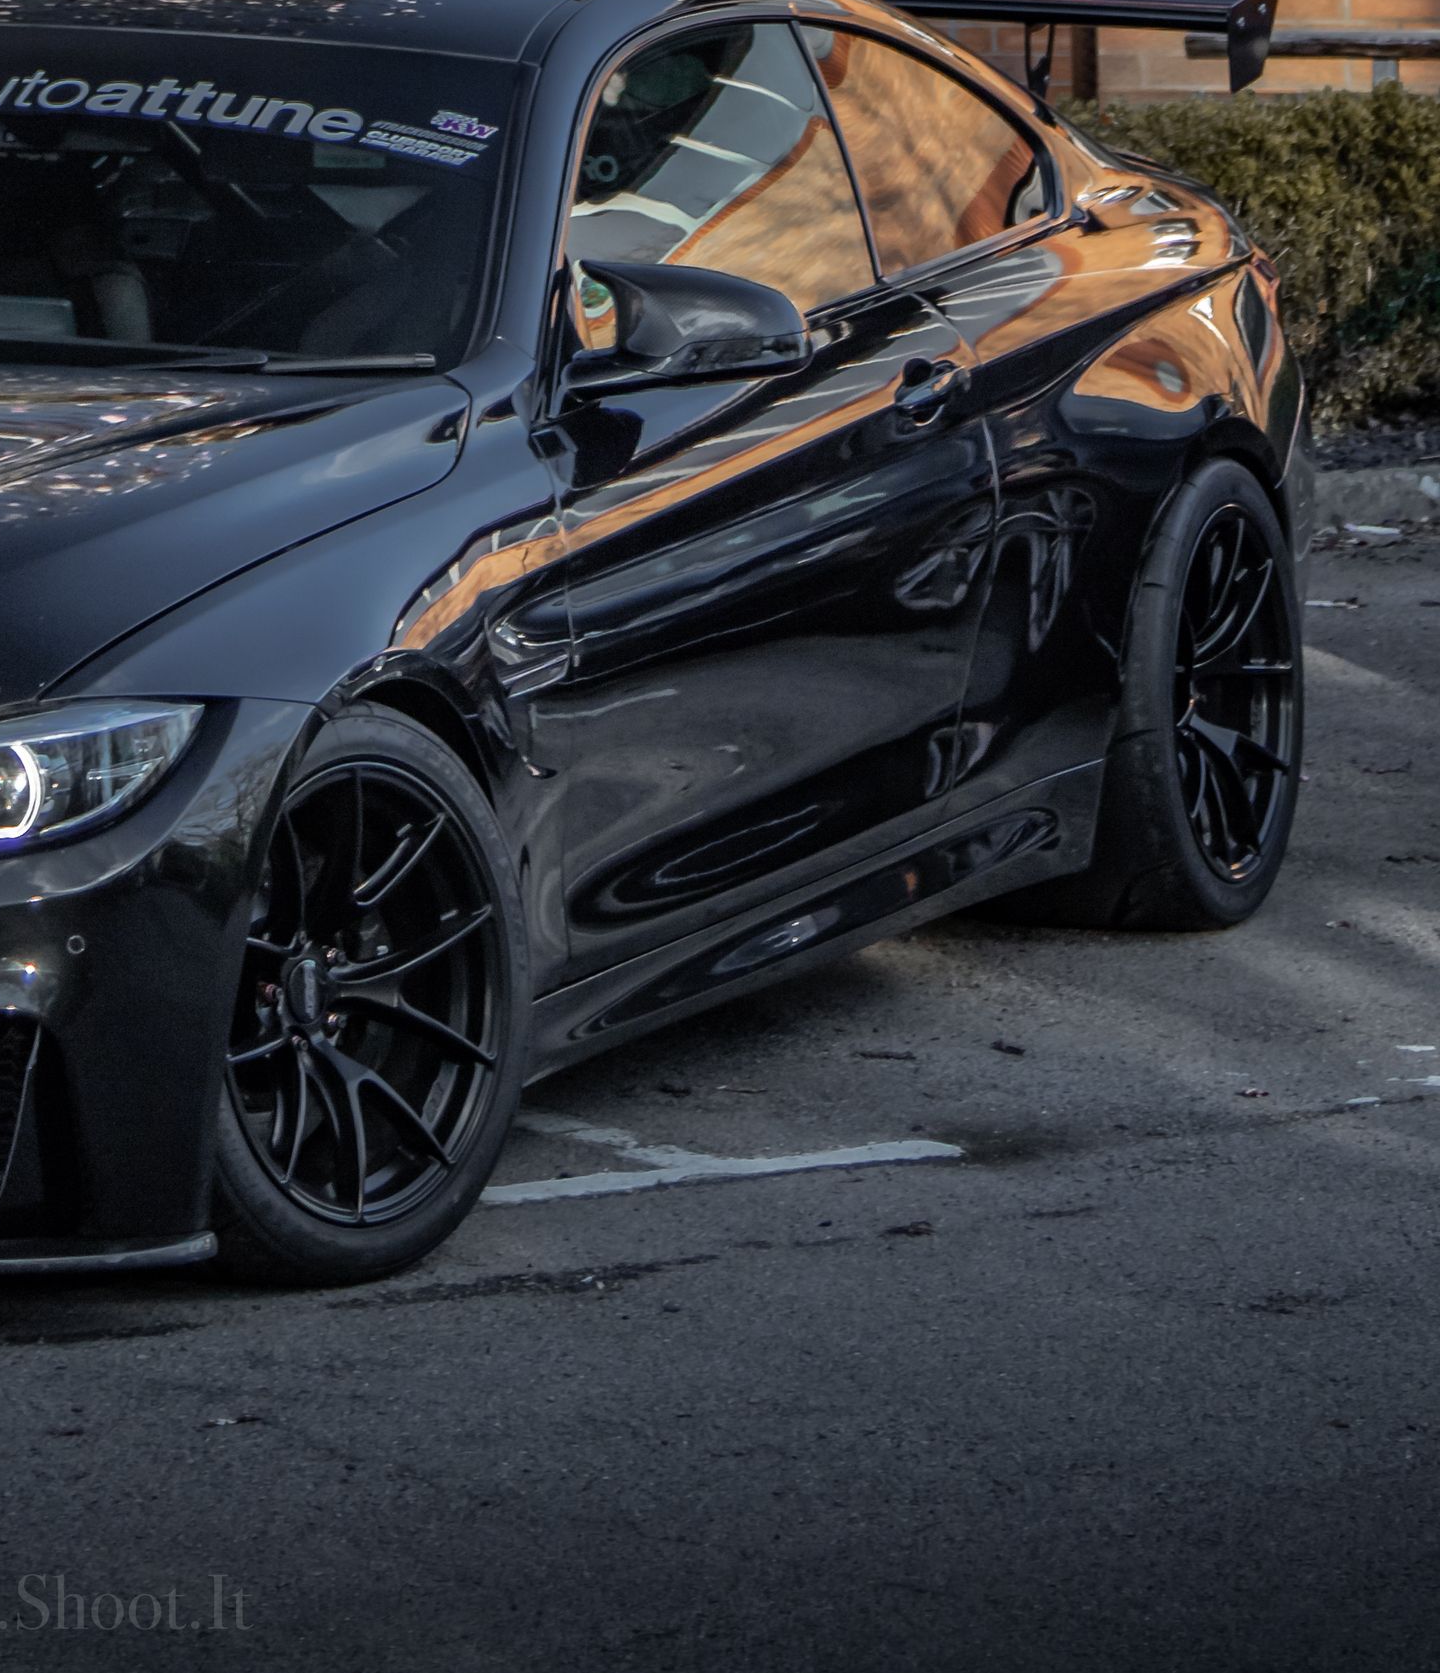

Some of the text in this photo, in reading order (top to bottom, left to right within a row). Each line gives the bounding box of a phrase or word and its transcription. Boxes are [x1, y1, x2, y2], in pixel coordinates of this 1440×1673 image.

[439, 117, 498, 139] KW
[366, 131, 480, 158] CLUBSPORT
[388, 143, 469, 165] GARAGE
